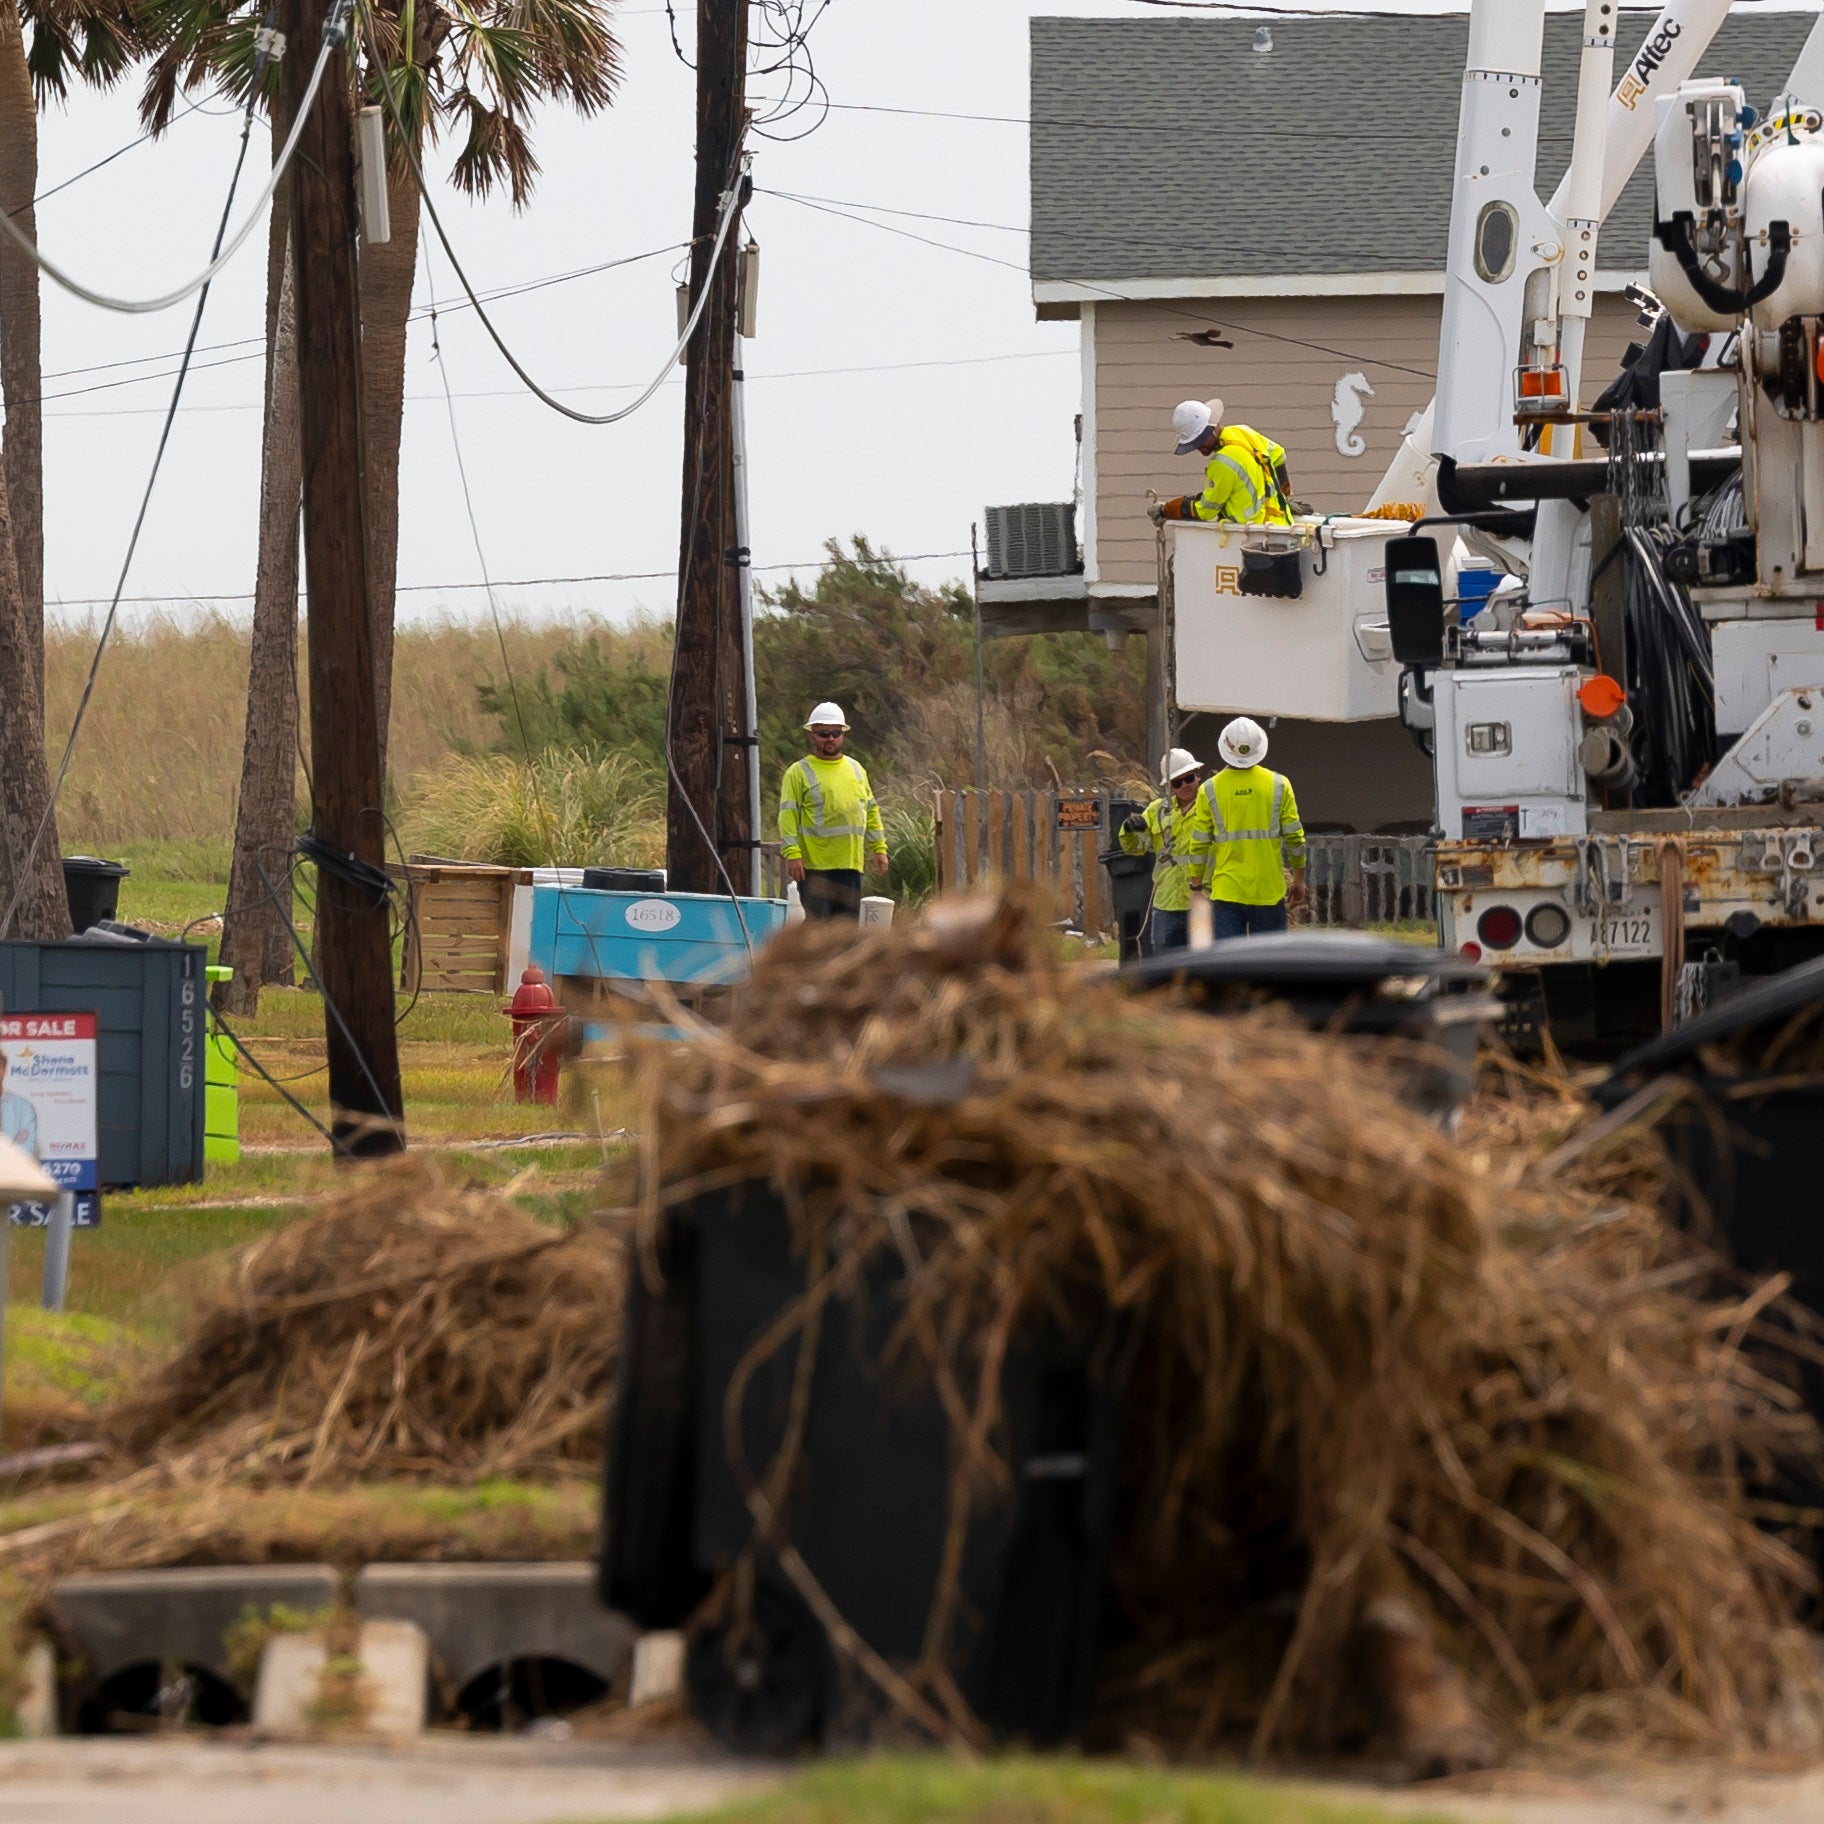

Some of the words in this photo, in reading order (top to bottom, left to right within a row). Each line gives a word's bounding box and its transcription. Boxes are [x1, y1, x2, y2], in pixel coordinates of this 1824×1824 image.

[1635, 18, 1682, 86] Altec
[632, 907, 674, 922] 16518
[26, 1019, 76, 1036] SALE
[180, 953, 194, 1088] 16526
